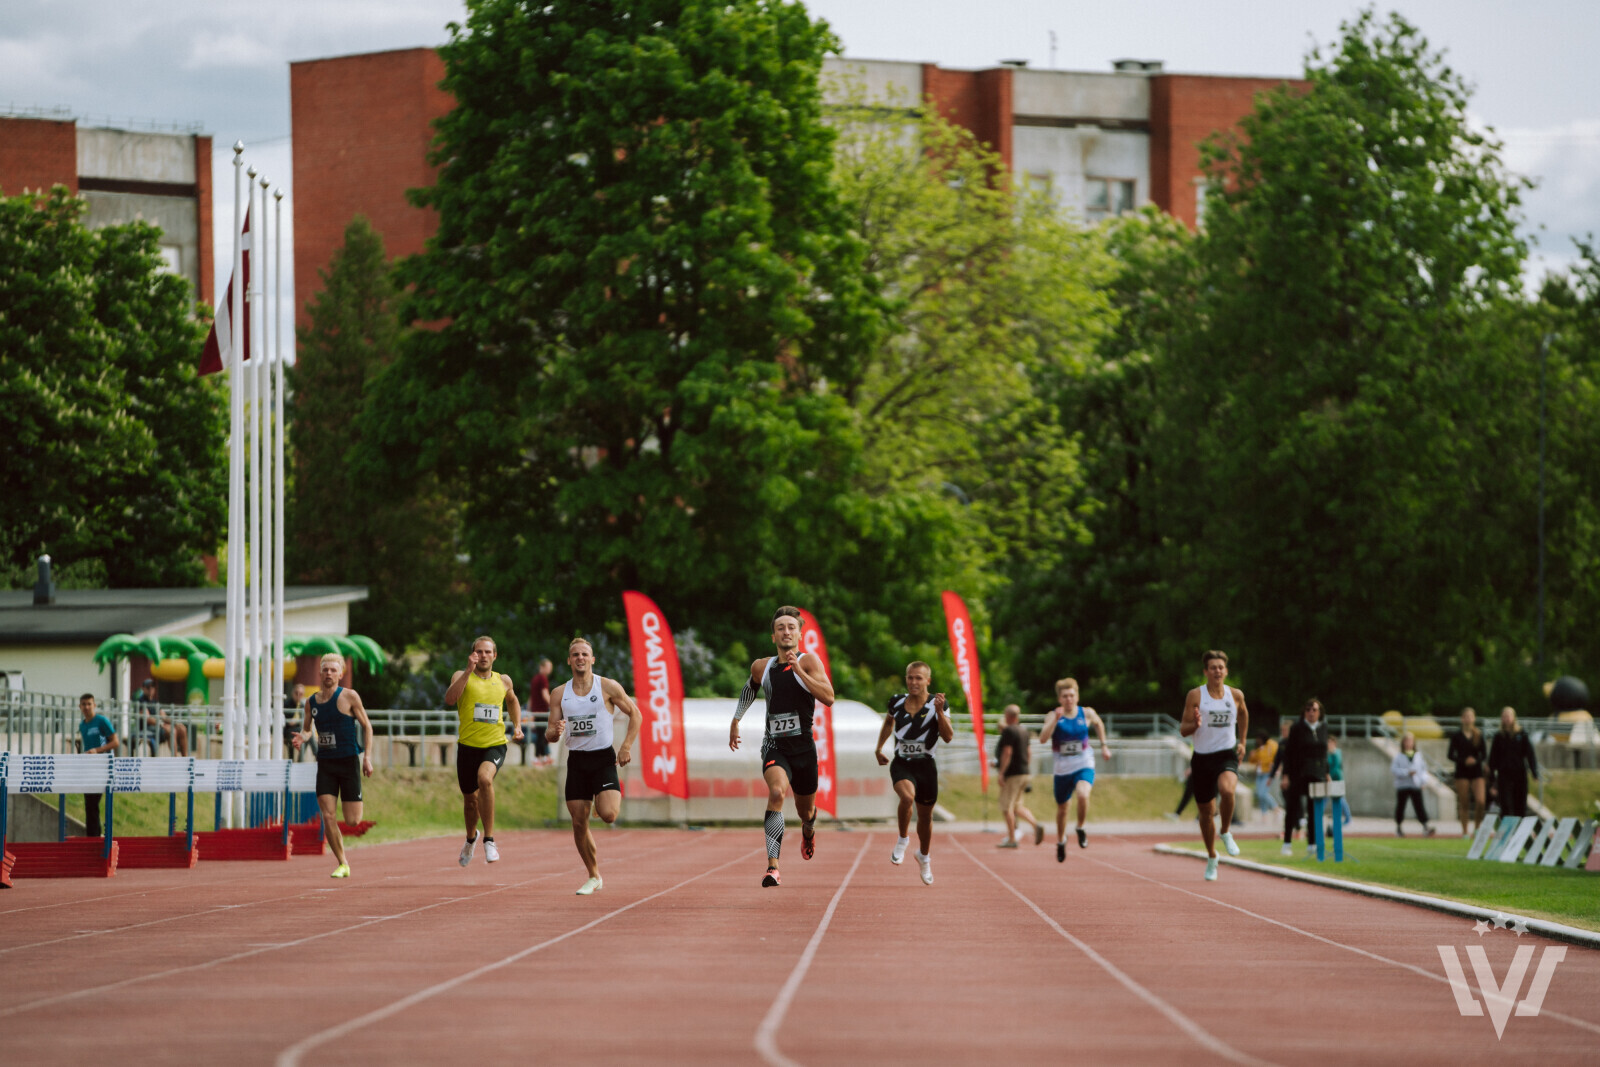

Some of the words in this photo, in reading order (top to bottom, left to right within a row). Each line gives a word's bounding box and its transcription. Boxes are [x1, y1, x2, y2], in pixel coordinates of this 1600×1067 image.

[483, 708, 492, 718] 11
[1212, 714, 1229, 723] 227
[572, 720, 594, 731] 205
[774, 718, 796, 731] 273
[902, 744, 922, 753] 204
